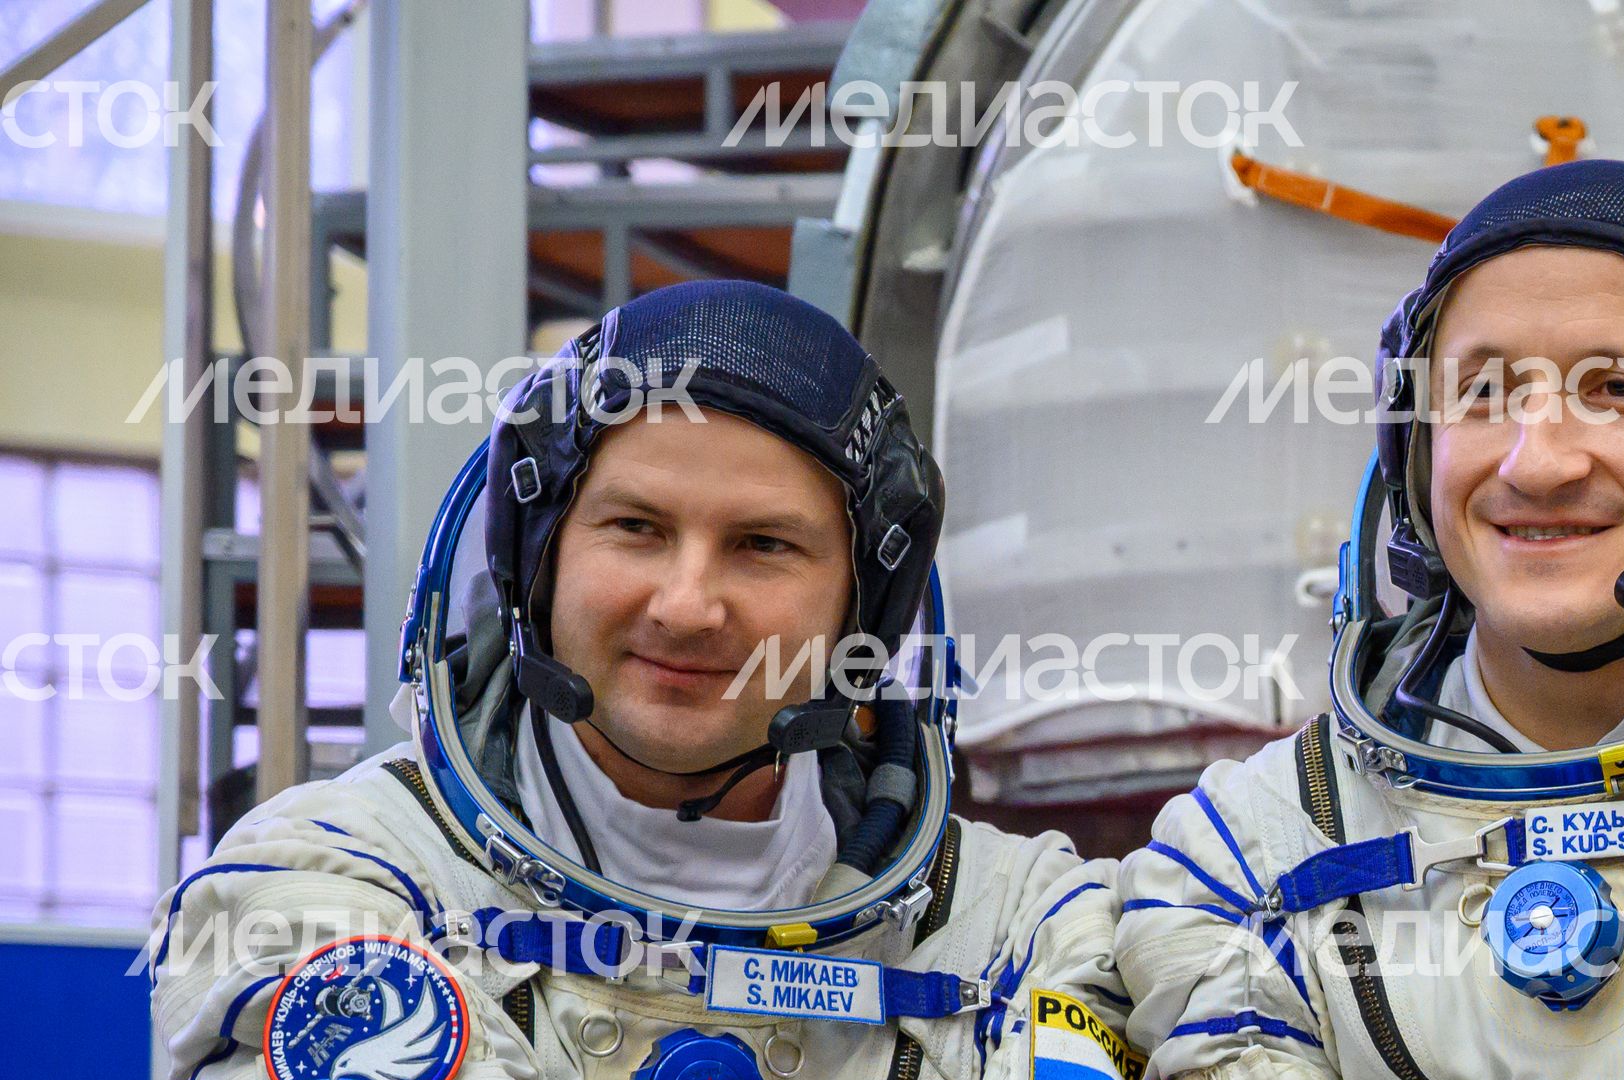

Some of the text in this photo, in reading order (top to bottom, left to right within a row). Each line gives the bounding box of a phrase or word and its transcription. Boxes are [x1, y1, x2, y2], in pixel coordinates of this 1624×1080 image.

[1532, 836, 1553, 856] S.
[364, 942, 428, 972] WILLIAMS
[770, 959, 860, 988] МИКАЕВ
[746, 983, 855, 1012] S. MIKAEV
